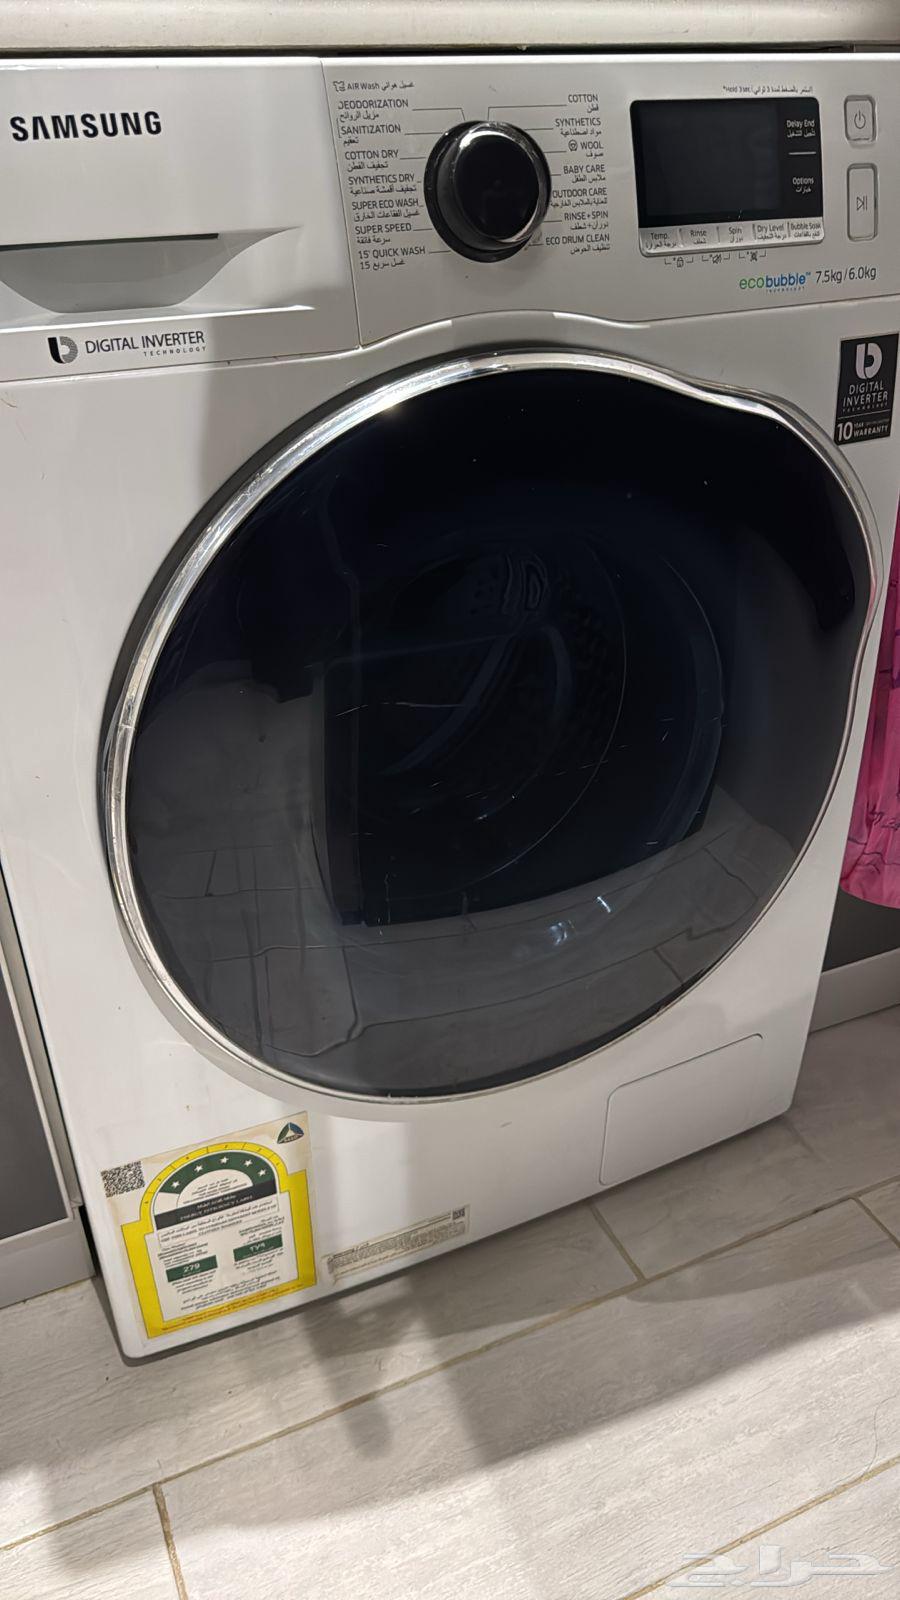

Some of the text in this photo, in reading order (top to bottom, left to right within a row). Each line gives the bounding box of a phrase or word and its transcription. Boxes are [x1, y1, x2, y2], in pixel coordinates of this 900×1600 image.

[361, 82, 380, 90] Wash
[568, 94, 598, 103] COTTON
[586, 103, 600, 113] قطن
[340, 110, 379, 122] مزيل الروائح
[10, 111, 162, 142] SAMSUNG
[555, 117, 601, 127] SYNTHETICS
[786, 119, 815, 129] Delay End
[341, 124, 401, 135] SANITIZATION
[343, 137, 359, 146] تعقيم
[580, 141, 604, 150] WOOL
[345, 149, 399, 160] COTTON DRY
[586, 151, 604, 159] صوف
[347, 161, 389, 172] تجفيف القطن
[563, 164, 606, 175] BABY CARE
[348, 173, 415, 185] SYNTHETICS DRY
[792, 176, 814, 185] Options
[552, 187, 607, 199] OUTDOOR CARE
[351, 199, 419, 211] SUPER ECO WASH
[564, 212, 586, 221] RINSE
[592, 211, 609, 220] SPIN
[355, 223, 412, 235] SUPER SPEED
[690, 229, 707, 237] Rinse
[728, 226, 743, 235] Spin
[757, 223, 785, 233] Dry Level
[545, 233, 610, 246] ECO DRUM CLEAN
[372, 248, 399, 259] QUICK
[401, 246, 426, 256] WASH
[360, 261, 371, 270] 15
[739, 273, 806, 289] ecobubble
[85, 330, 206, 354] DIGITAL INVERTER
[143, 346, 207, 357] TECHNOLOGY
[848, 380, 884, 395] DIGITAL
[842, 391, 888, 408] INVERTER
[837, 421, 853, 442] 10
[853, 425, 888, 438] WARRANTY
[183, 1262, 200, 1273] 279
